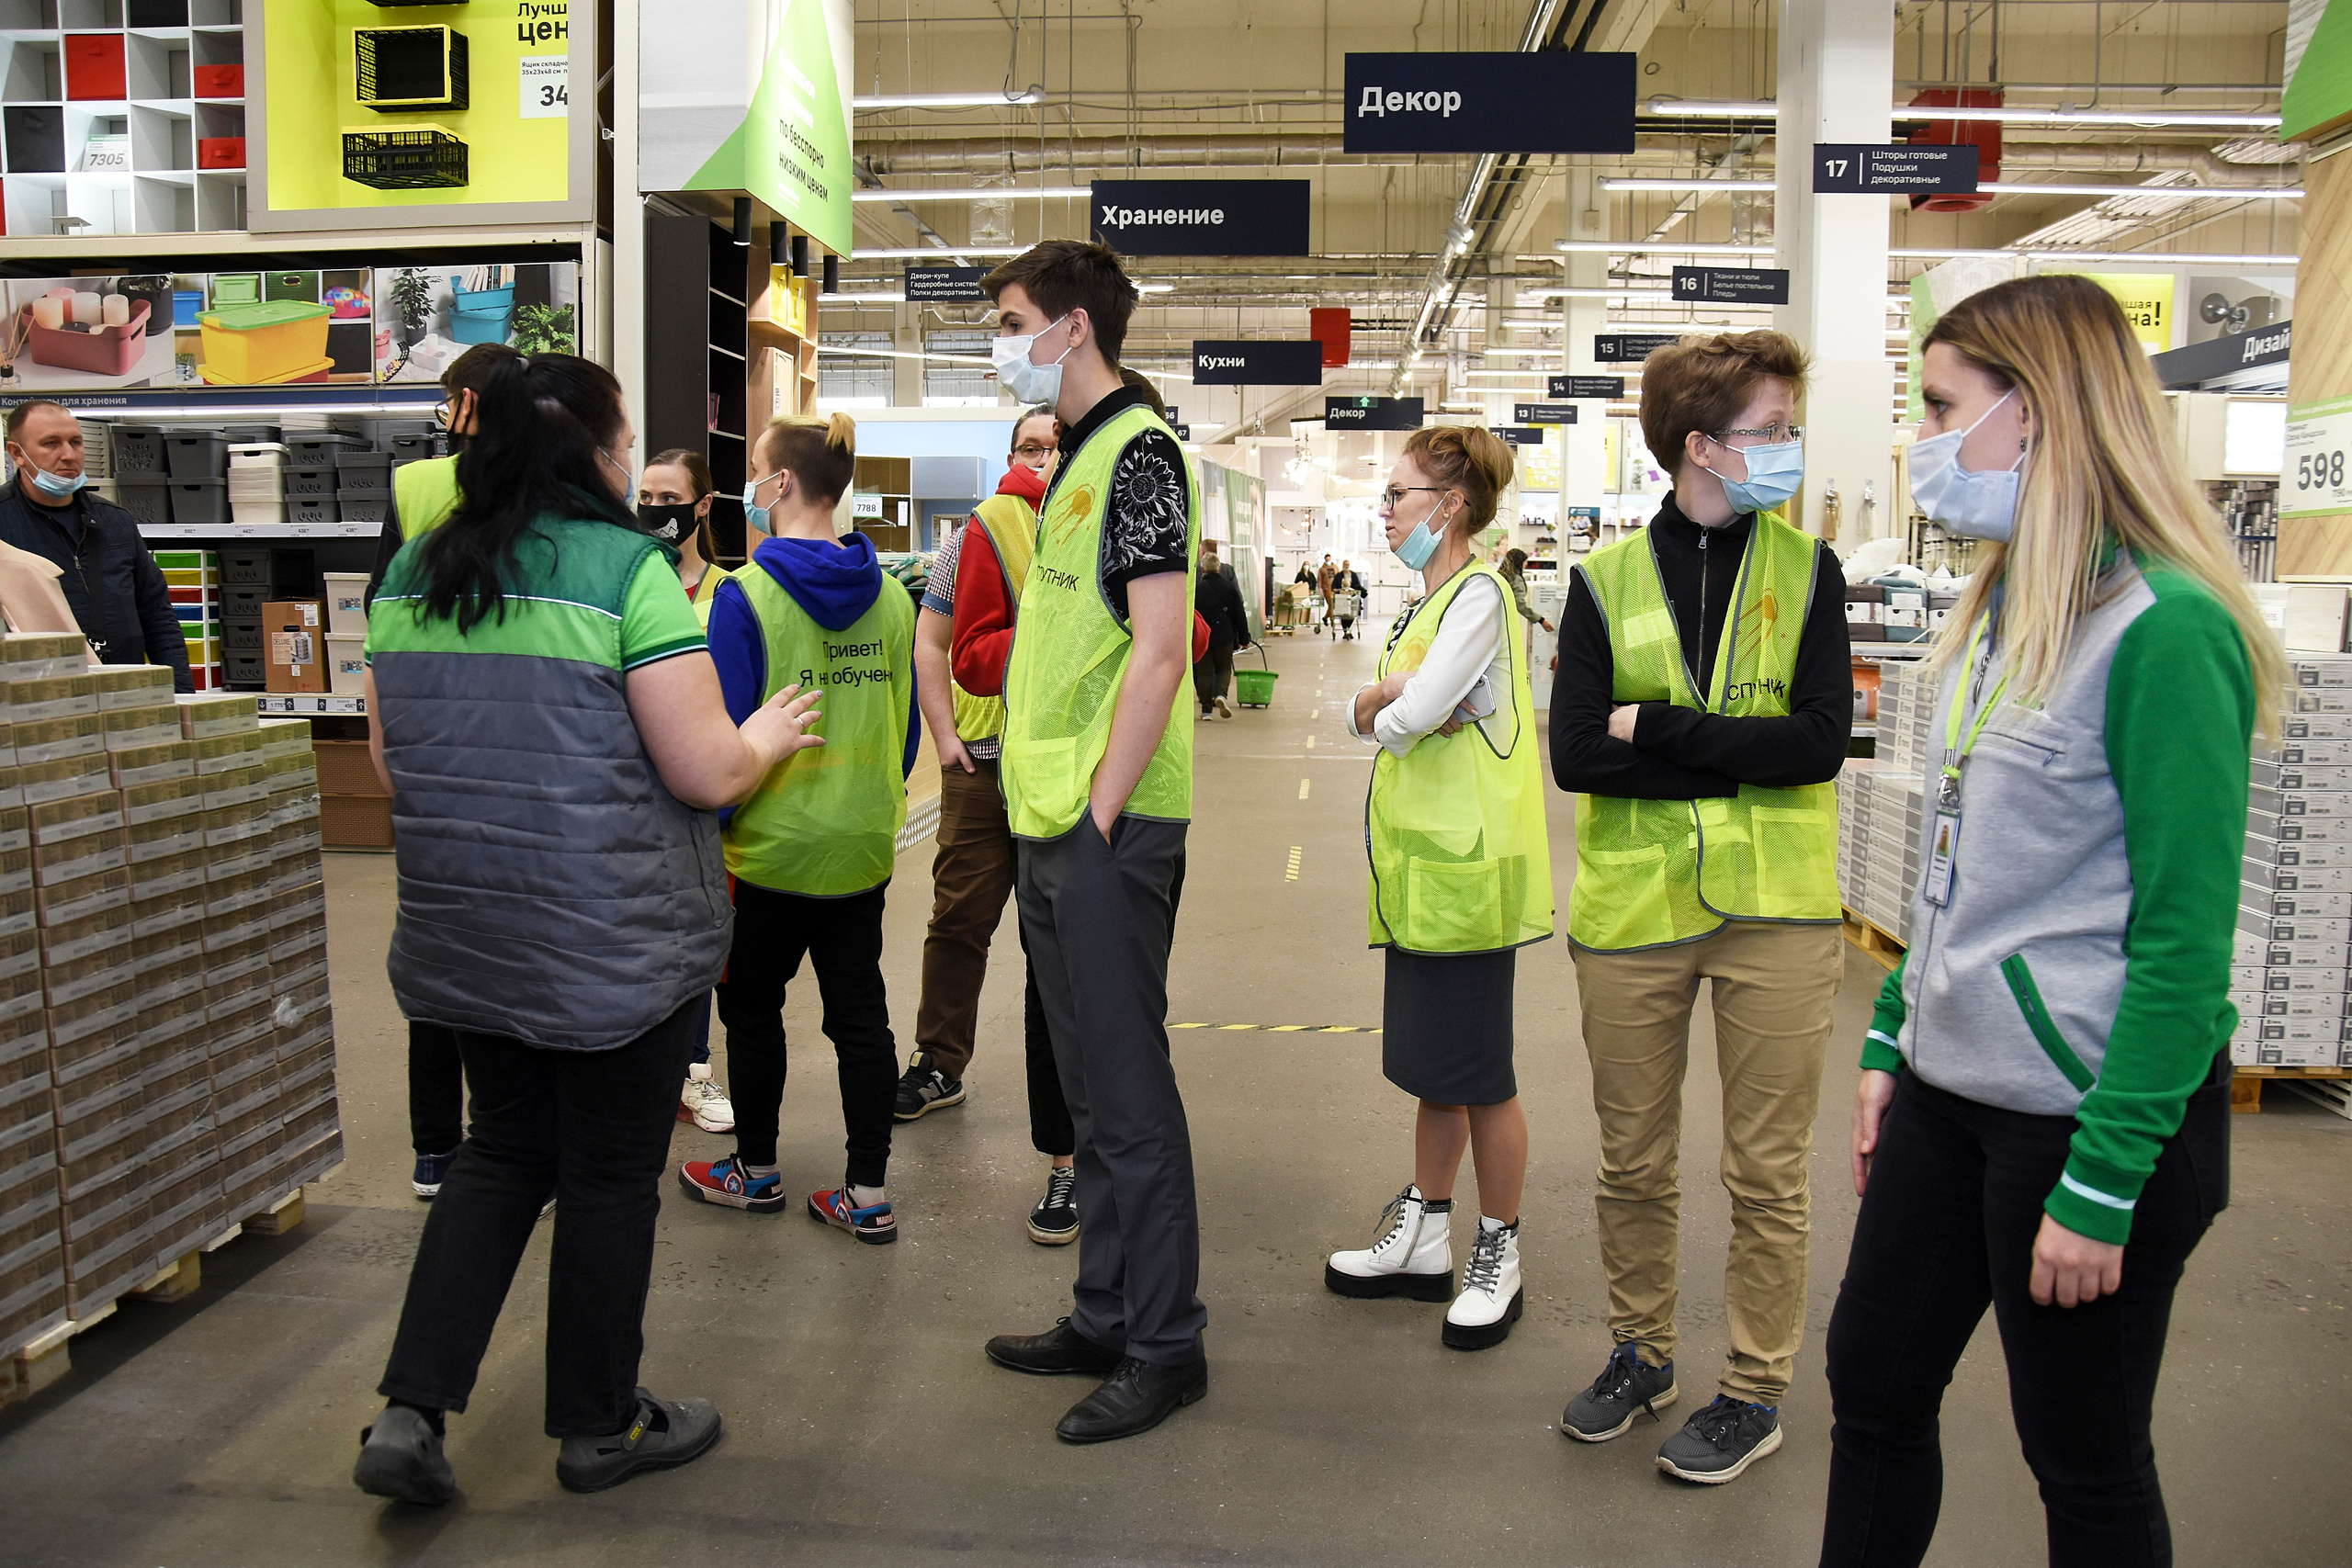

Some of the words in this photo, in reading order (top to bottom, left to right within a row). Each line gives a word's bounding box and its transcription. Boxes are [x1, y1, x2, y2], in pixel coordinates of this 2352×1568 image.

[517, 3, 567, 19] Лучш
[517, 20, 568, 46] цен
[540, 85, 568, 107] 34
[1358, 86, 1462, 118] Декор
[780, 118, 788, 138] по
[789, 124, 824, 169] бесспорно
[89, 152, 125, 166] 7305
[1871, 151, 1907, 161] Шторы
[1909, 152, 1948, 160] готовые
[1825, 160, 1848, 177] 17
[1871, 164, 1918, 174] Подушки
[779, 152, 806, 186] низким
[807, 175, 828, 202] ценам
[1871, 175, 1941, 186] декоративные
[1102, 205, 1225, 230] Хранение
[1679, 277, 1698, 290] 16
[1600, 344, 1614, 354] 15
[2243, 328, 2291, 363] Дизай
[1198, 355, 1245, 370] Кухни
[1553, 382, 1565, 391] 14
[62, 398, 78, 407] для
[82, 397, 127, 407] хранения
[1329, 408, 1366, 419] Декор
[1518, 410, 1529, 418] 13
[2298, 450, 2345, 491] 598
[856, 504, 876, 513] 7788
[800, 670, 813, 687] Я
[832, 667, 893, 687] обучен
